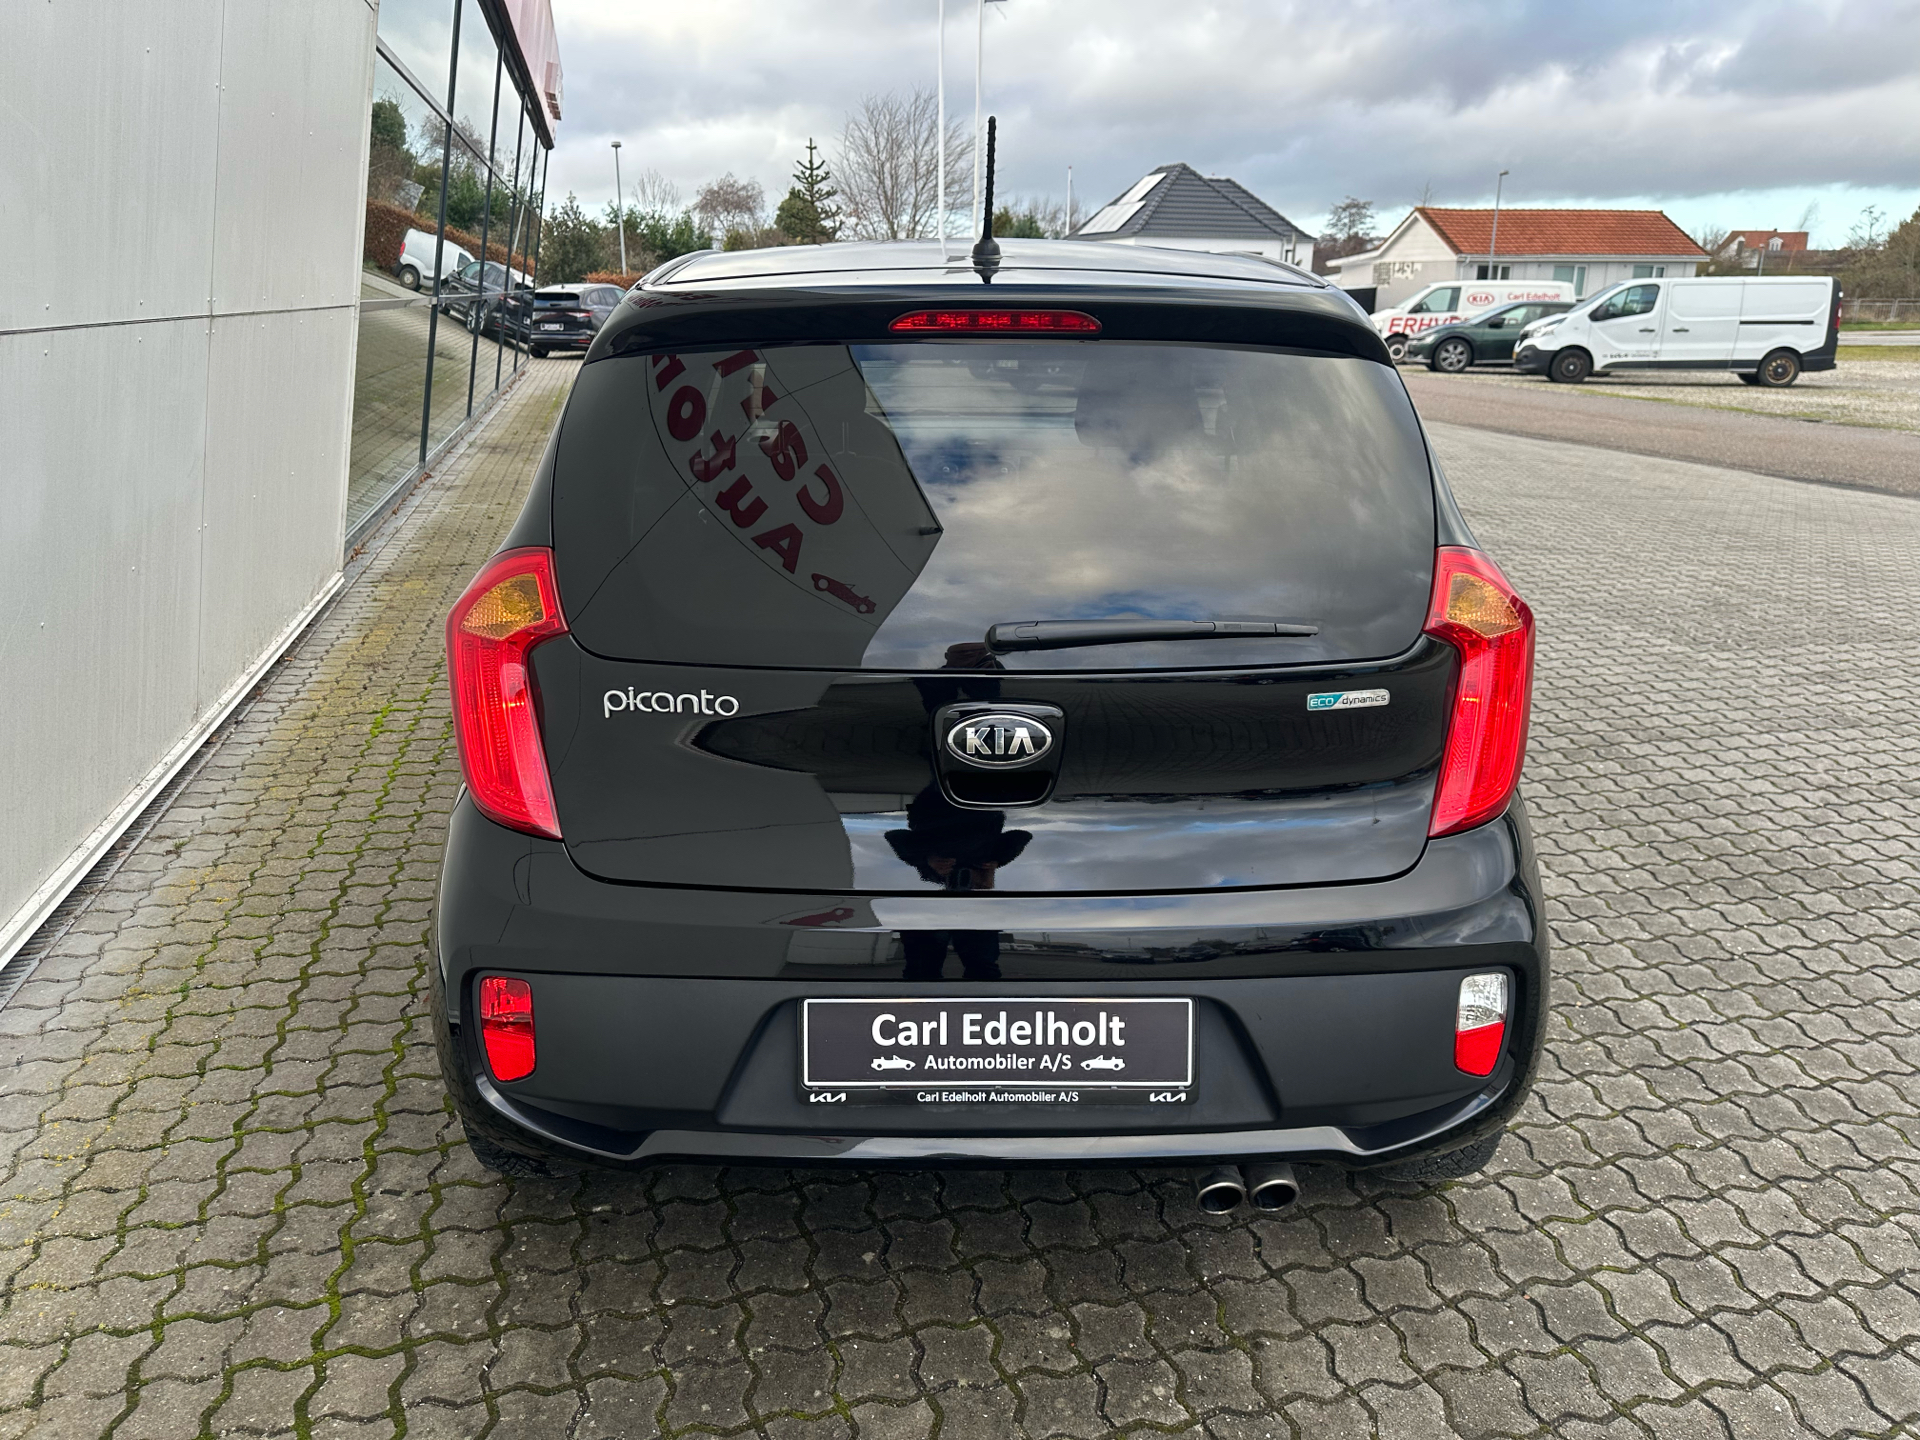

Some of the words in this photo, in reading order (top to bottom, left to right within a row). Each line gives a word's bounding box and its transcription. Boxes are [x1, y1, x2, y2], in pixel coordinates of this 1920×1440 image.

[603, 686, 740, 719] picanto
[1310, 697, 1334, 707] ECO
[1341, 694, 1387, 706] dynamics
[965, 727, 1036, 755] KIA
[871, 1011, 948, 1047] Carl
[962, 1010, 1126, 1047] Edelholt
[924, 1053, 1036, 1071] Automobiler
[1039, 1053, 1072, 1073] A/S
[916, 1090, 940, 1103] Carl
[941, 1090, 987, 1104] Edelholt
[988, 1090, 1057, 1104] Automobiler
[1058, 1091, 1079, 1104] A/S
